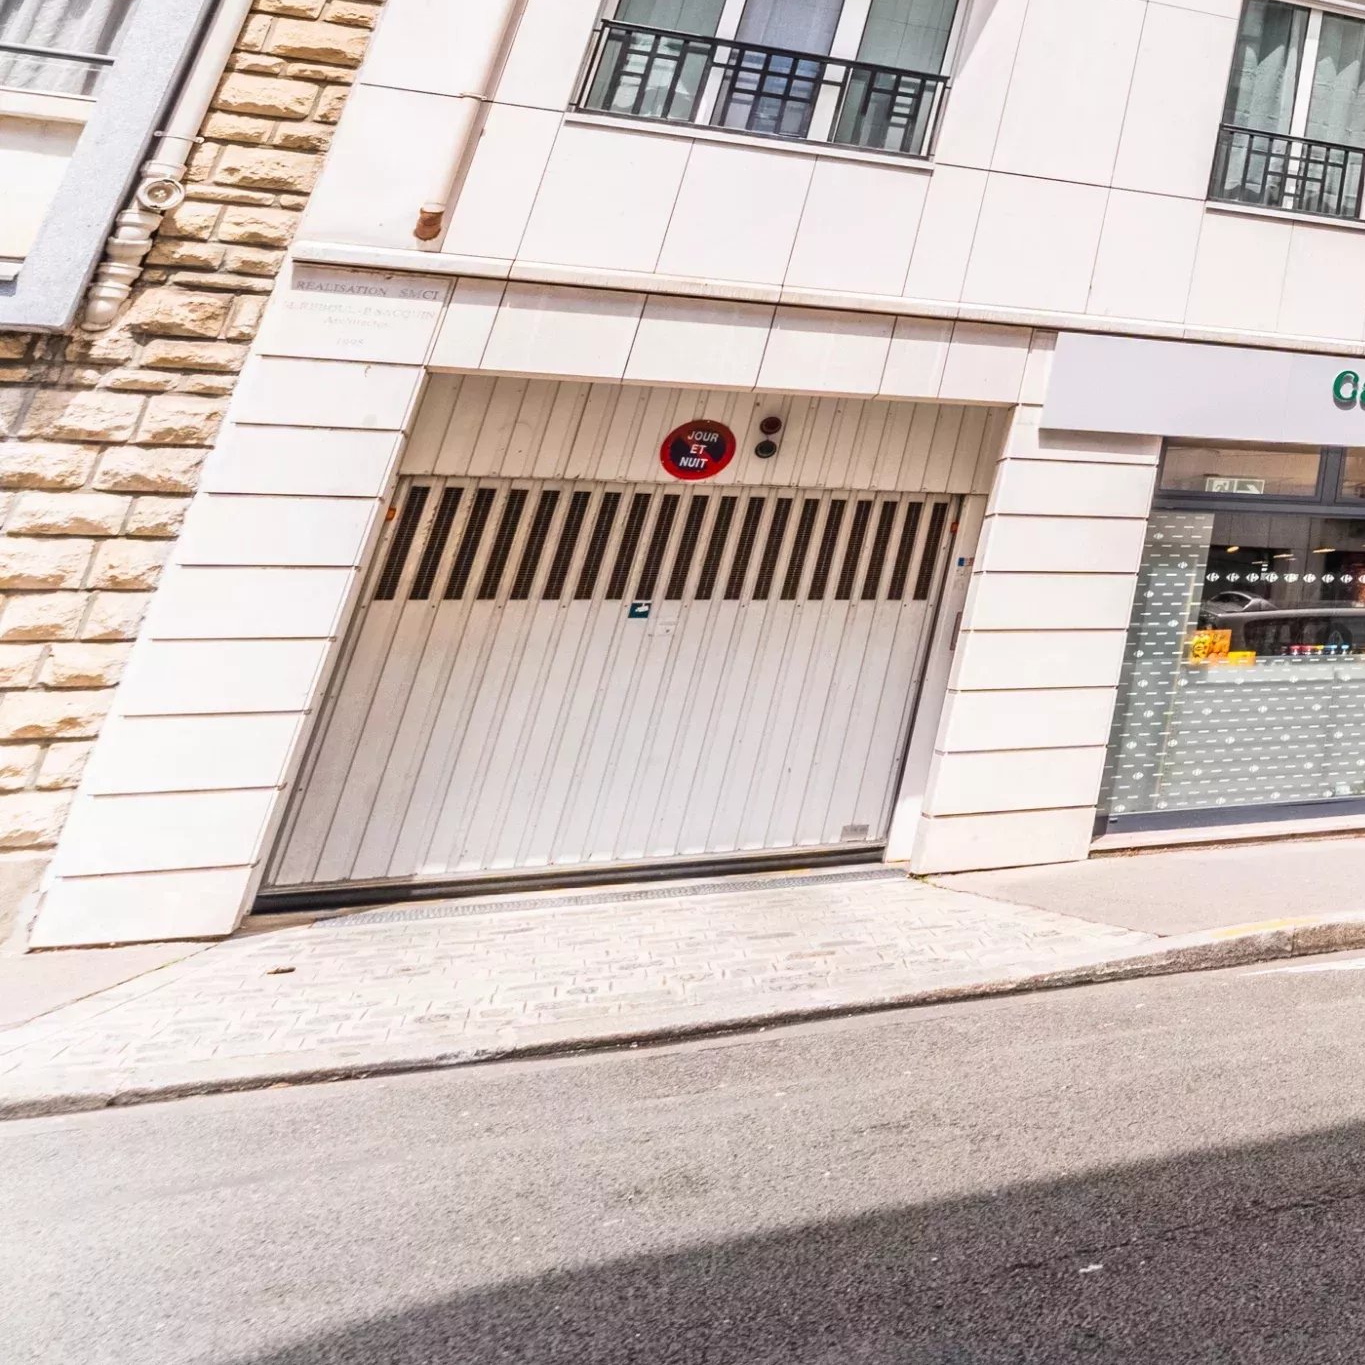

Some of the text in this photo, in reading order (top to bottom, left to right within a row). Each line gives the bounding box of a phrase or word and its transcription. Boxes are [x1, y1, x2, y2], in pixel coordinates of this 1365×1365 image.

[296, 280, 389, 297] REALISATION
[687, 431, 719, 443] JOUR
[690, 444, 707, 455] ET
[679, 456, 708, 469] NUIT
